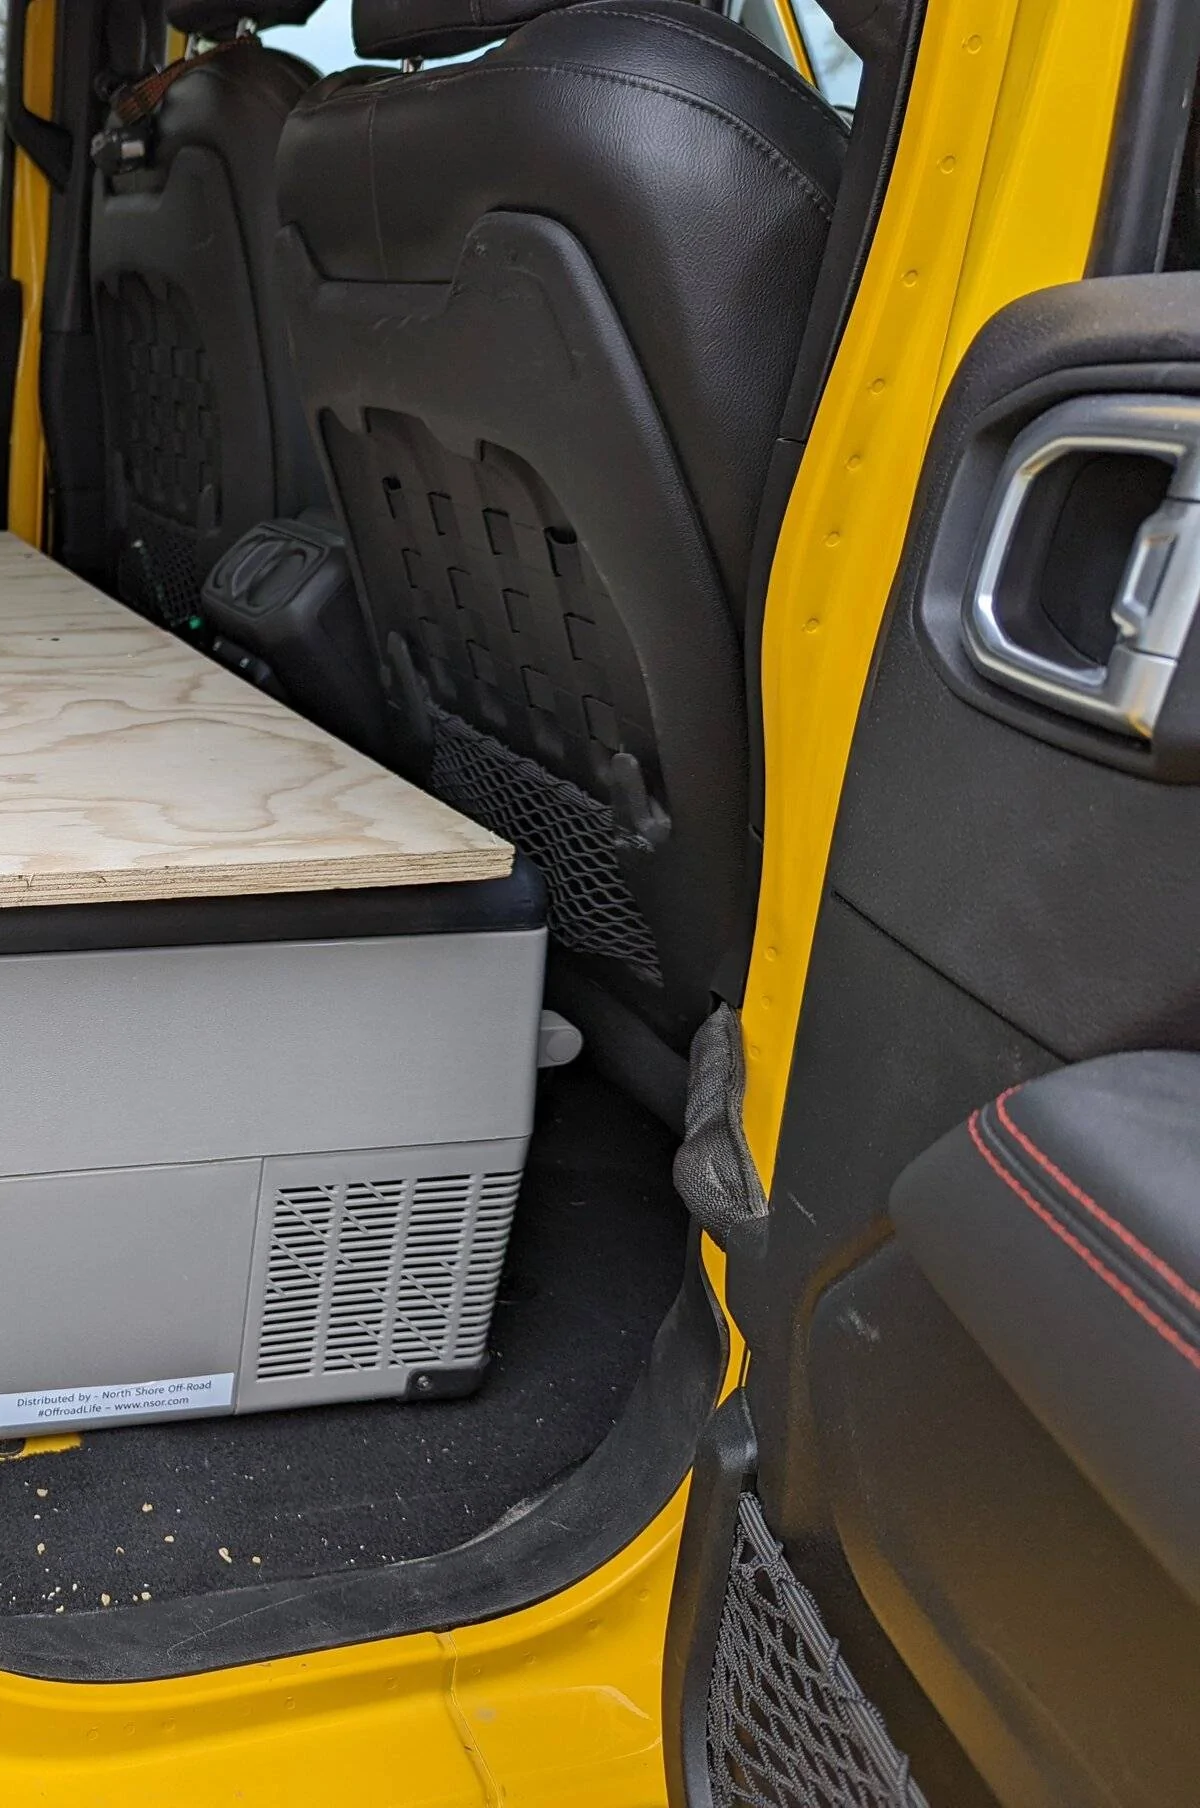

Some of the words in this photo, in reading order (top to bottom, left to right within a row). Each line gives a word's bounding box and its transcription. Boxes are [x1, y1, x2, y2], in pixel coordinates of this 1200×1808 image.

[17, 1394, 75, 1407] Distributed
[78, 1393, 91, 1402] by
[102, 1389, 132, 1399] North
[135, 1386, 165, 1396] Shore
[168, 1380, 212, 1393] Off-Road
[38, 1403, 102, 1417] #OffroadLife
[114, 1397, 189, 1410] www.nsor.com
